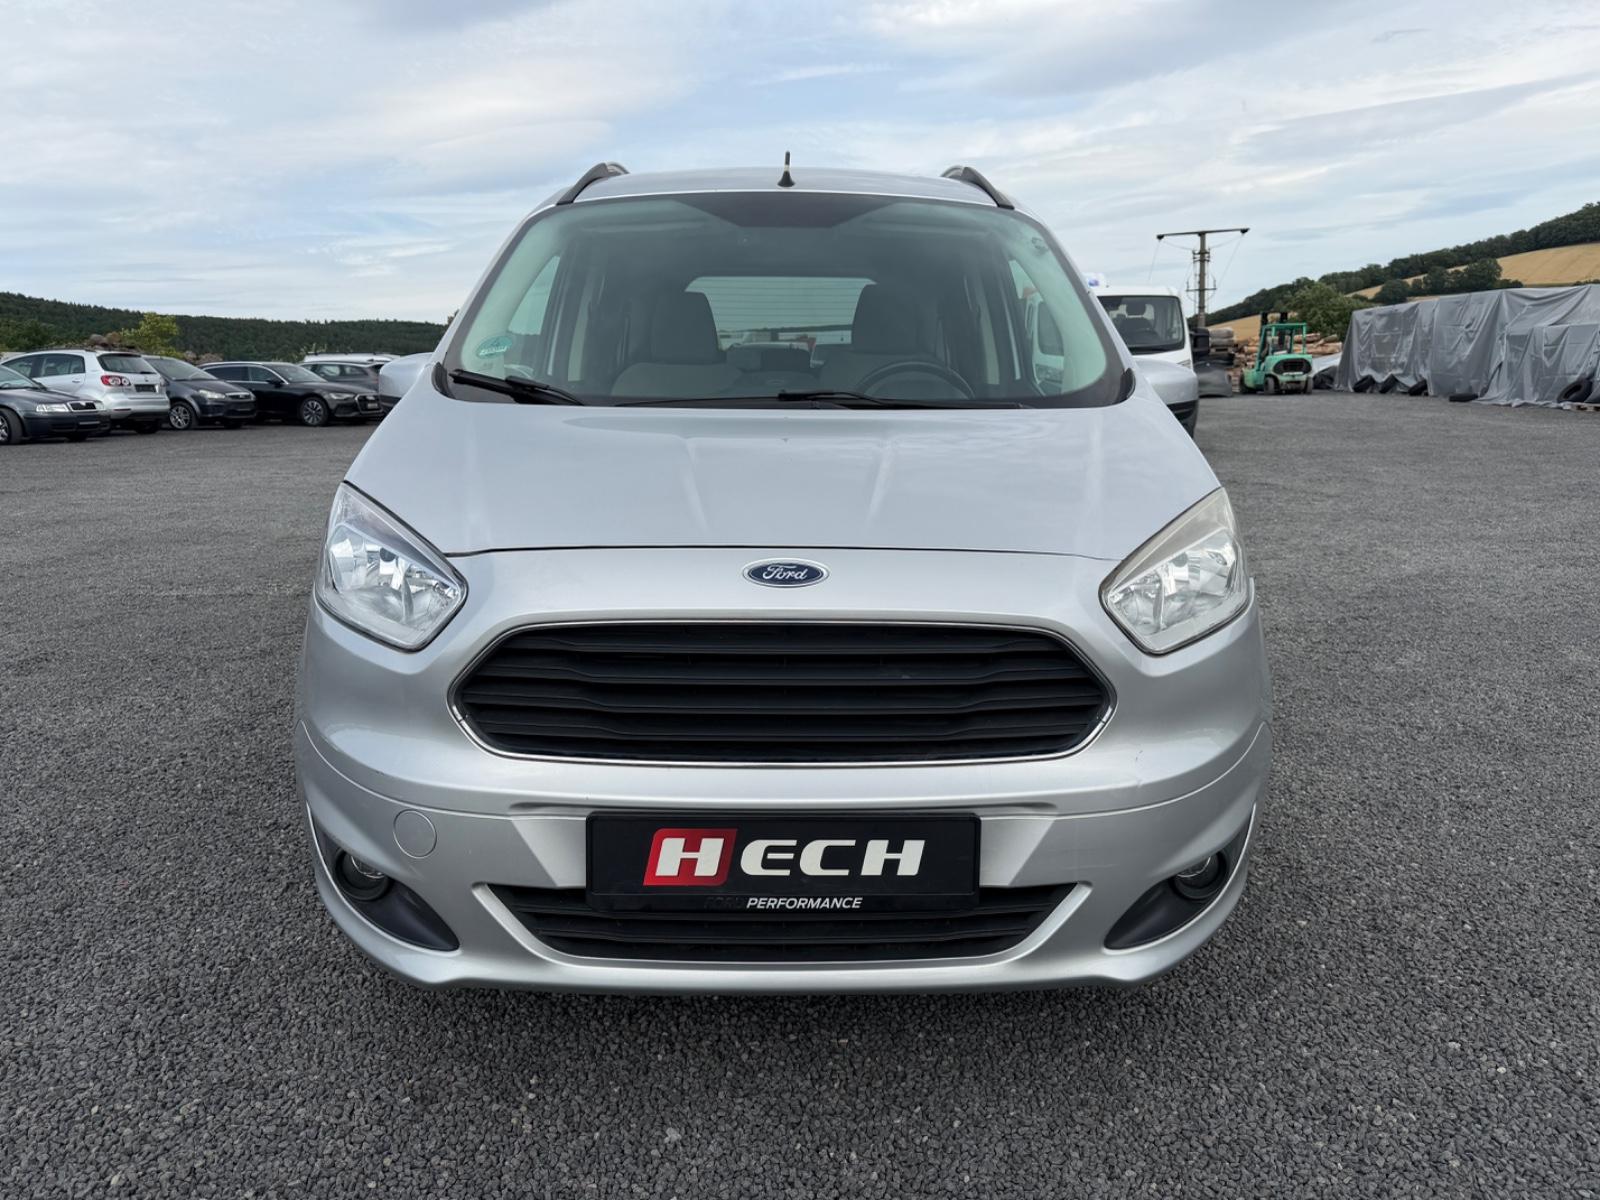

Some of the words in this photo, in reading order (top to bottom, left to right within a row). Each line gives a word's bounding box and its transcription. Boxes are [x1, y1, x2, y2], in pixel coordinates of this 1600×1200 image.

[762, 564, 808, 580] Ford
[655, 837, 926, 877] HECH
[745, 896, 863, 910] PERFORMANCE
